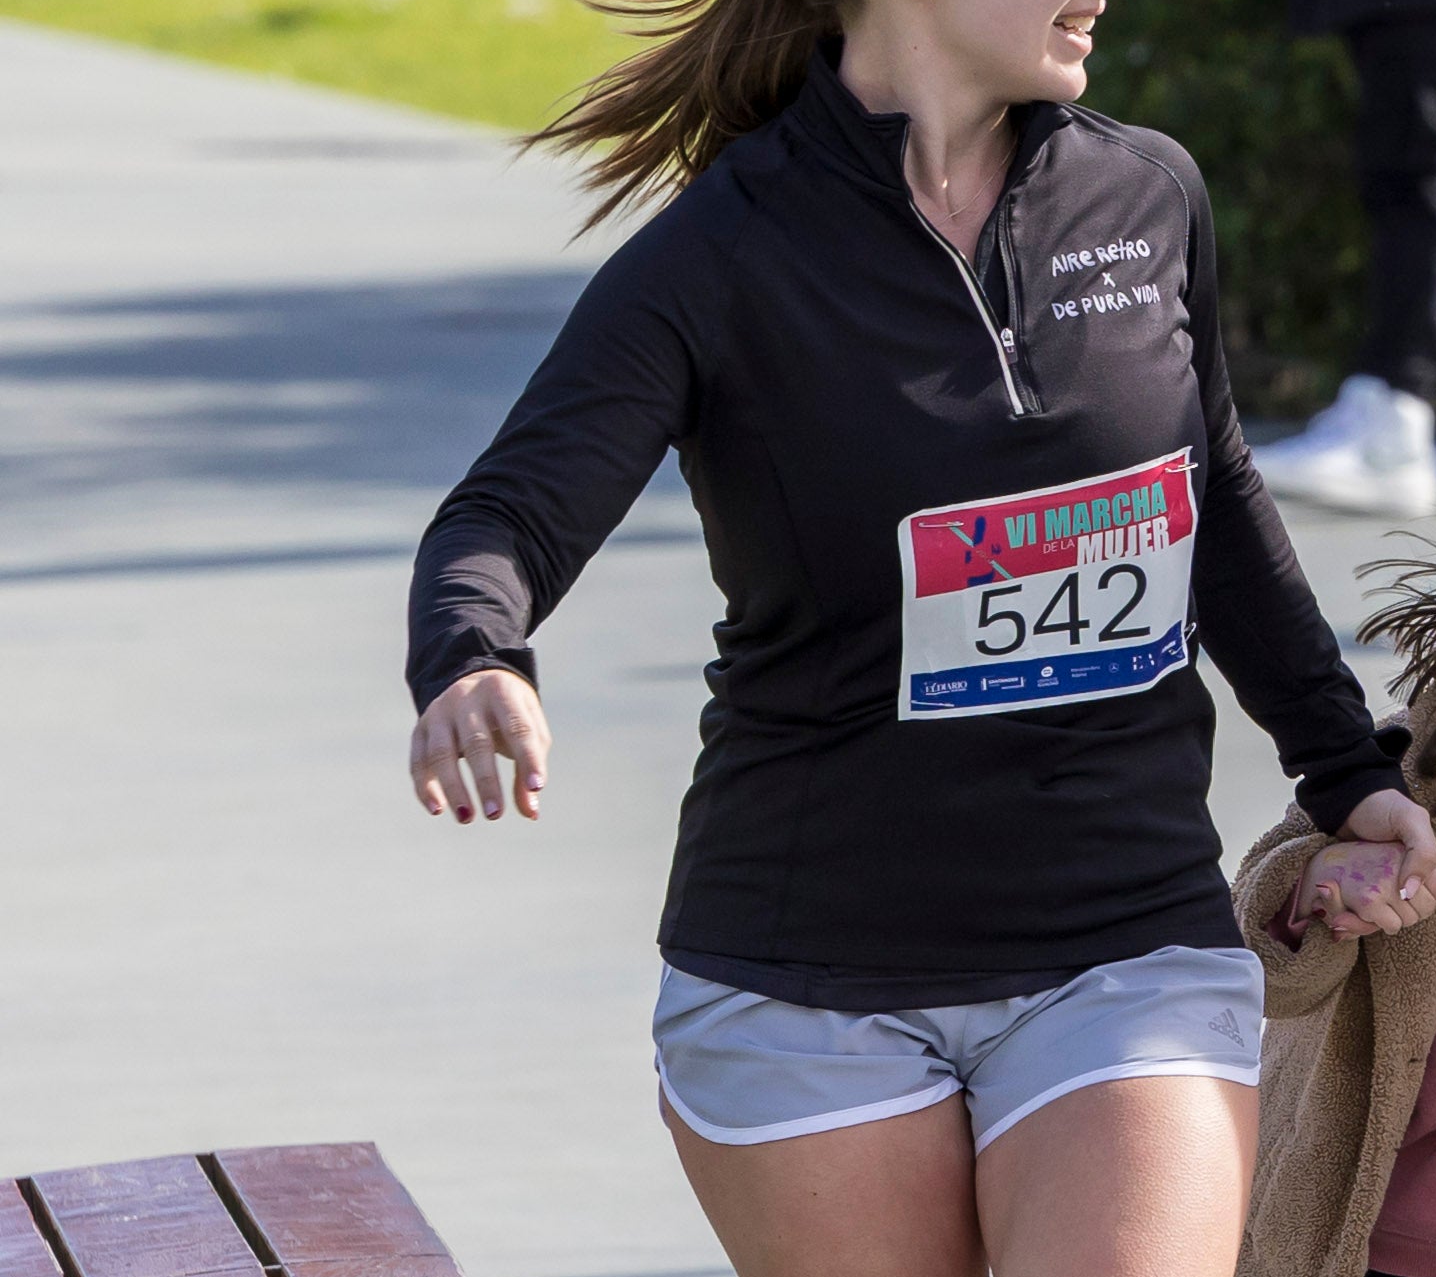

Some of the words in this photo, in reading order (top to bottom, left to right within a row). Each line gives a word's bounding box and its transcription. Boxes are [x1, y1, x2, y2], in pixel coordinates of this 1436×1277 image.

[1081, 291, 1132, 314] PURA
[1131, 284, 1161, 304] VIDA
[1004, 512, 1037, 549] VI
[1044, 481, 1168, 542] MARCHA
[1043, 542, 1059, 554] DE
[1060, 540, 1075, 552] LA
[1077, 515, 1170, 566] MUJER
[975, 562, 1151, 656] 542
